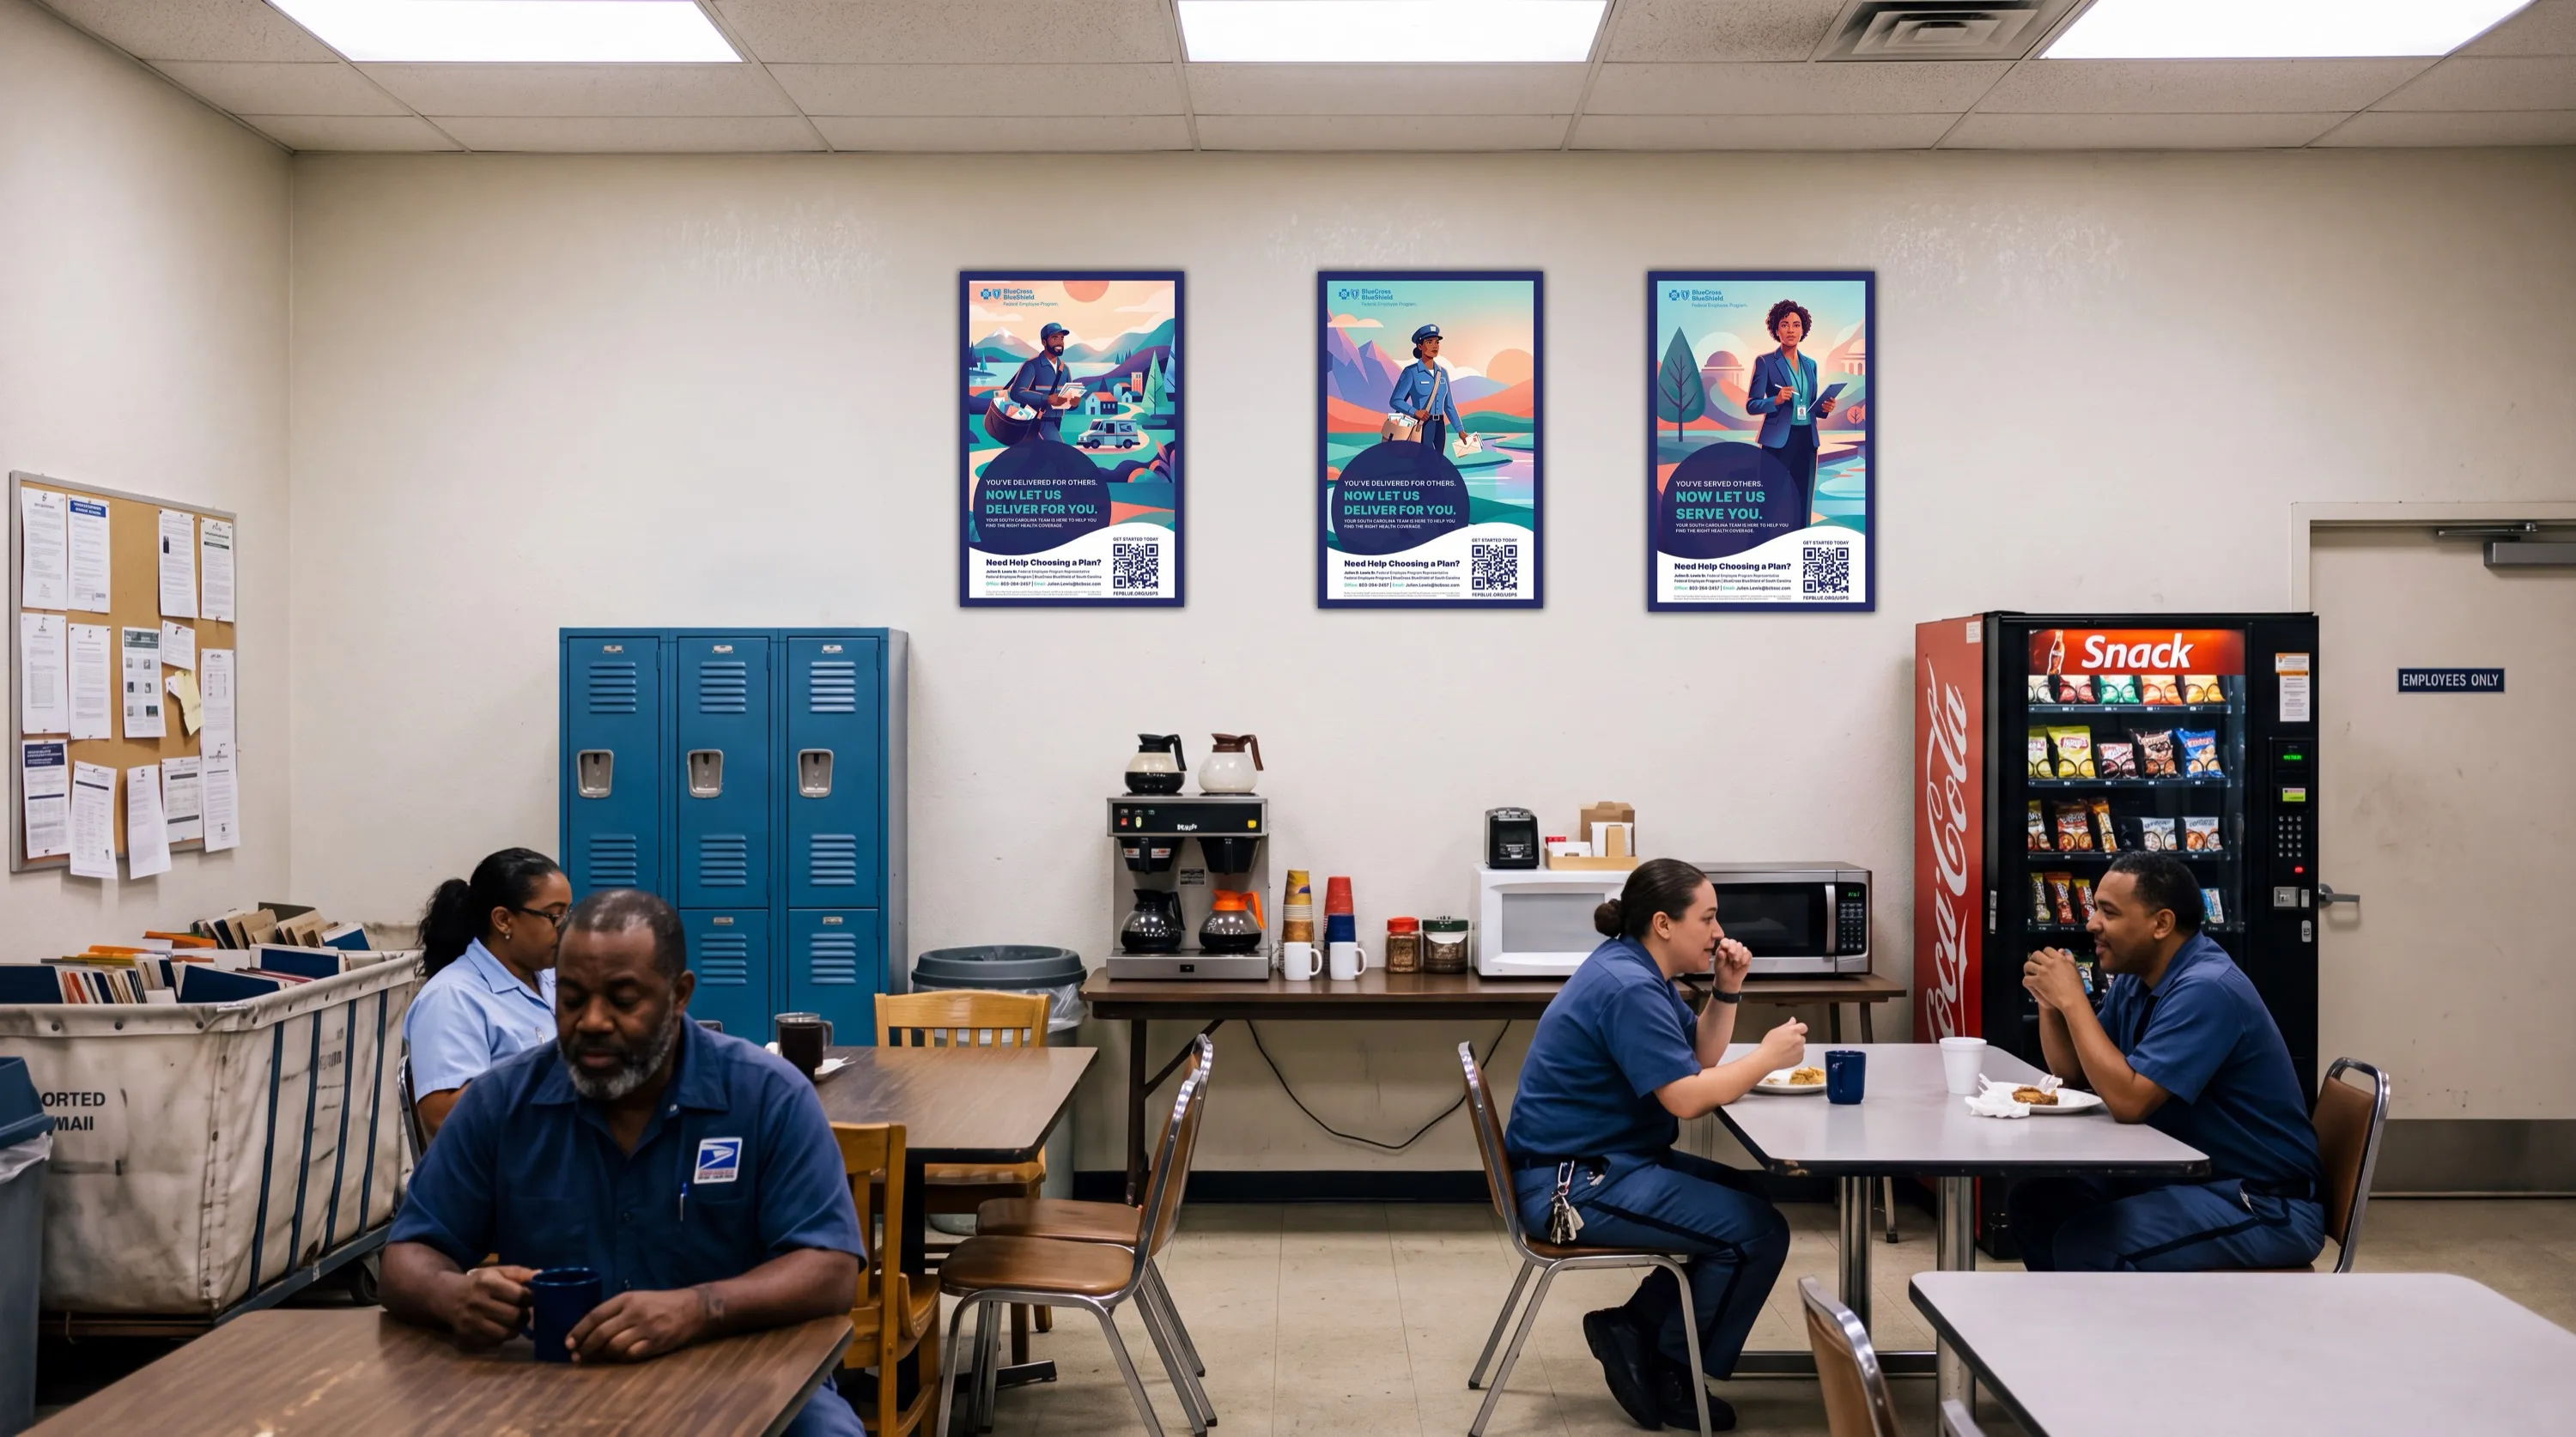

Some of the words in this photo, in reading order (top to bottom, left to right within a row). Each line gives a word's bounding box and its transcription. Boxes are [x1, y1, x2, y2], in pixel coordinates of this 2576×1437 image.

[986, 490, 1017, 500] NOW
[1019, 490, 1042, 500] LET
[1045, 490, 1061, 500] US
[1344, 491, 1375, 500] NOW
[1378, 491, 1400, 500] LET
[1403, 491, 1419, 500] US
[1675, 491, 1712, 502] NOW
[1716, 491, 1742, 502] LET
[1746, 491, 1765, 502] US
[986, 504, 1038, 514] DELIVER
[1041, 504, 1065, 514] FOR
[1068, 504, 1097, 514] YOU.
[1344, 506, 1397, 515] DELIVER
[1400, 506, 1424, 515] FOR
[1426, 506, 1456, 515] YOU.
[1675, 508, 1724, 519] SERVE
[1727, 508, 1763, 519] YOU.
[1009, 559, 1029, 567] Help
[1030, 559, 1070, 567] Choosing
[1368, 560, 1387, 568] Help
[1388, 560, 1429, 568] Choosing
[1719, 563, 1759, 572] Choosing
[2081, 633, 2194, 669] Snack
[2403, 674, 2466, 686] EMPLOYEES
[2471, 674, 2499, 686] ONLY
[41, 1092, 106, 1107] ORTED
